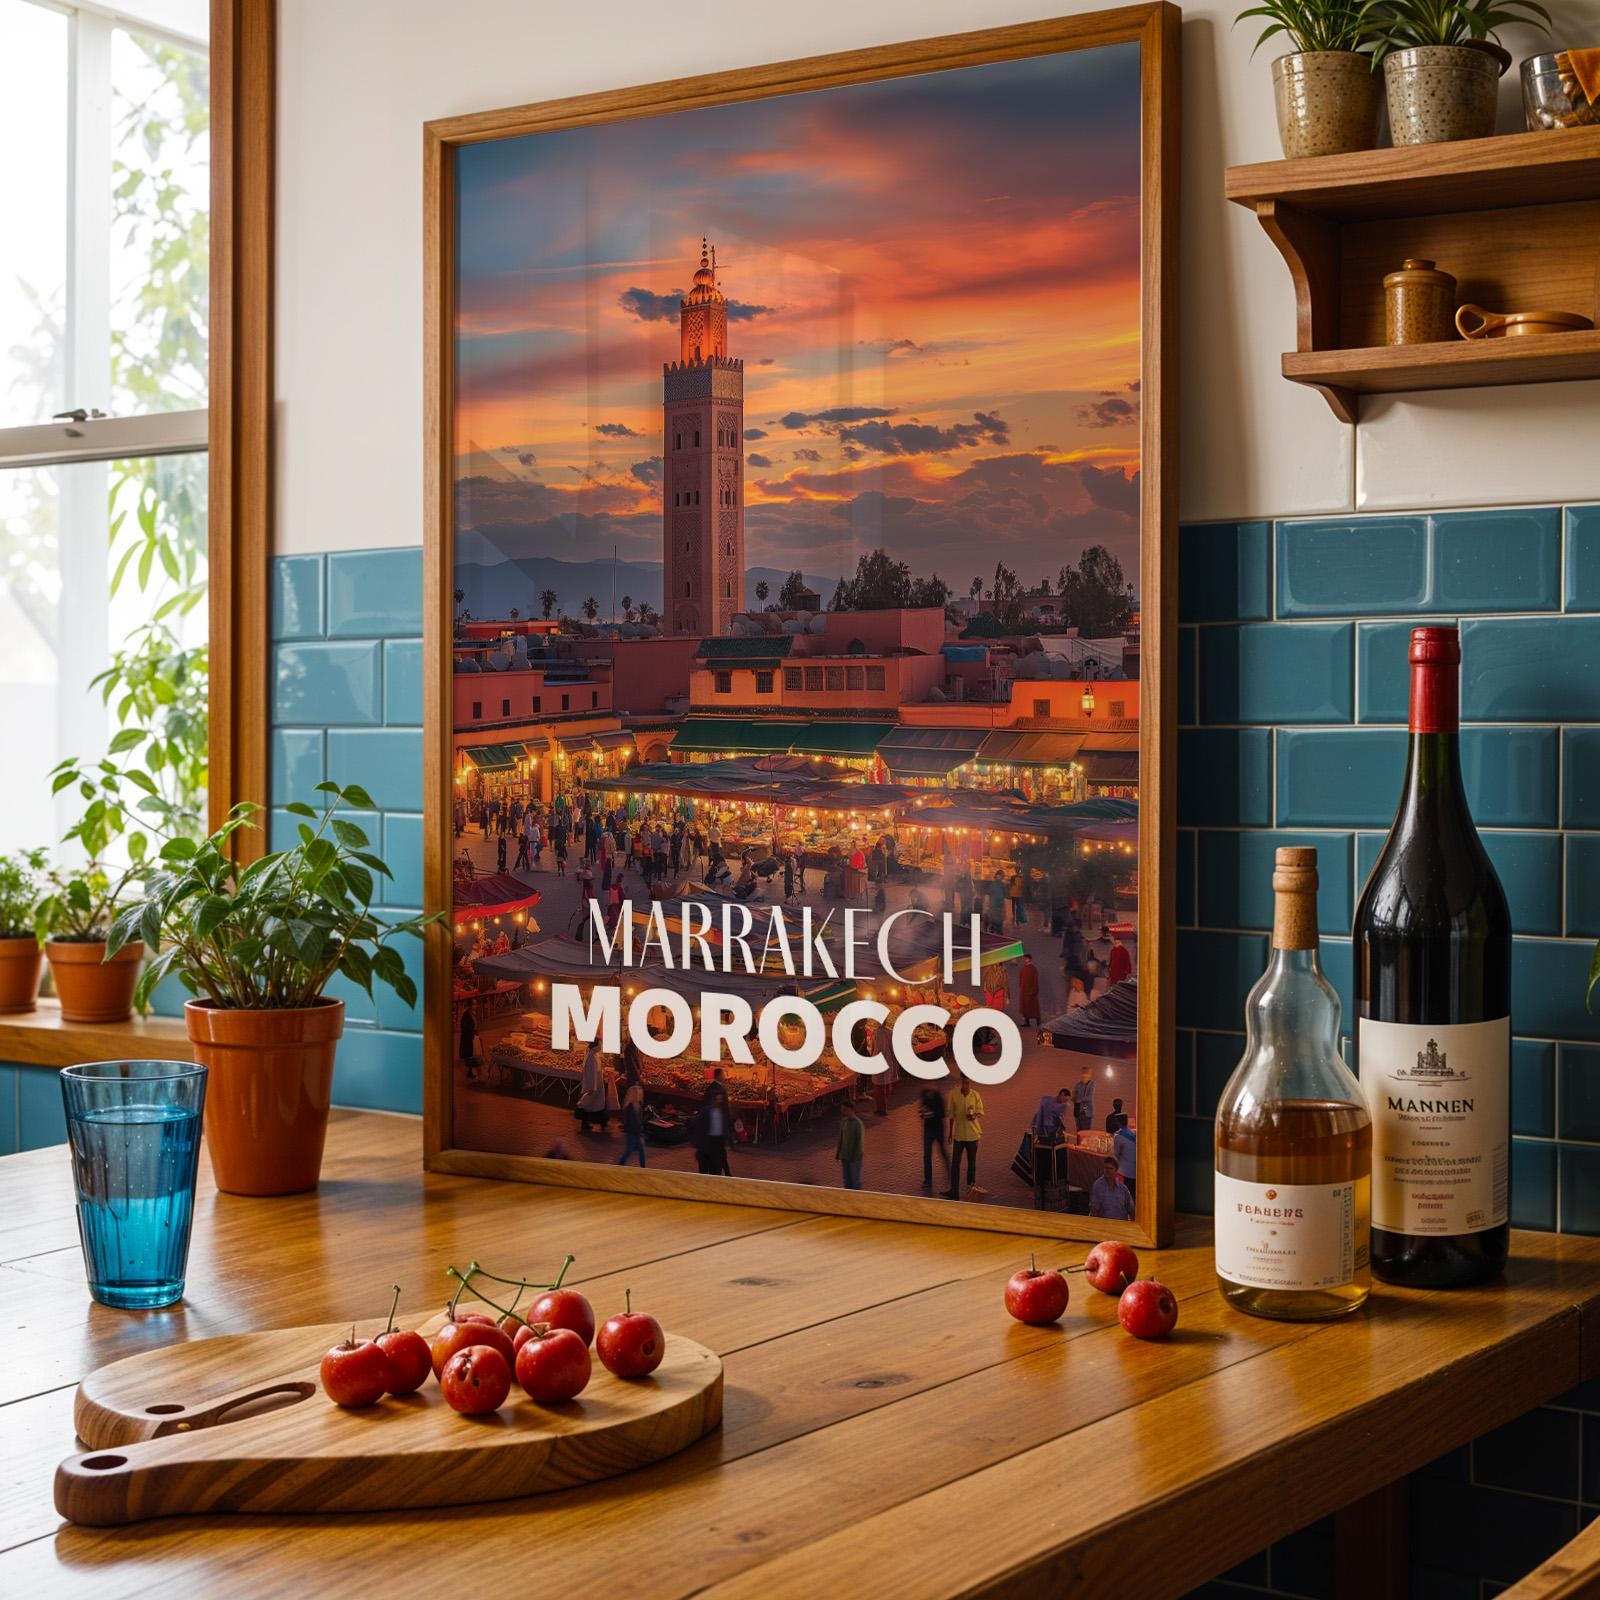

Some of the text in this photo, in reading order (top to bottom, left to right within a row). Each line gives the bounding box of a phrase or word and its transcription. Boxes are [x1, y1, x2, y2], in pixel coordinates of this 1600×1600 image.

[589, 898, 982, 987] MARRAKECH
[551, 983, 1023, 1085] MOROCCO
[1387, 1096, 1474, 1113] MANNEN
